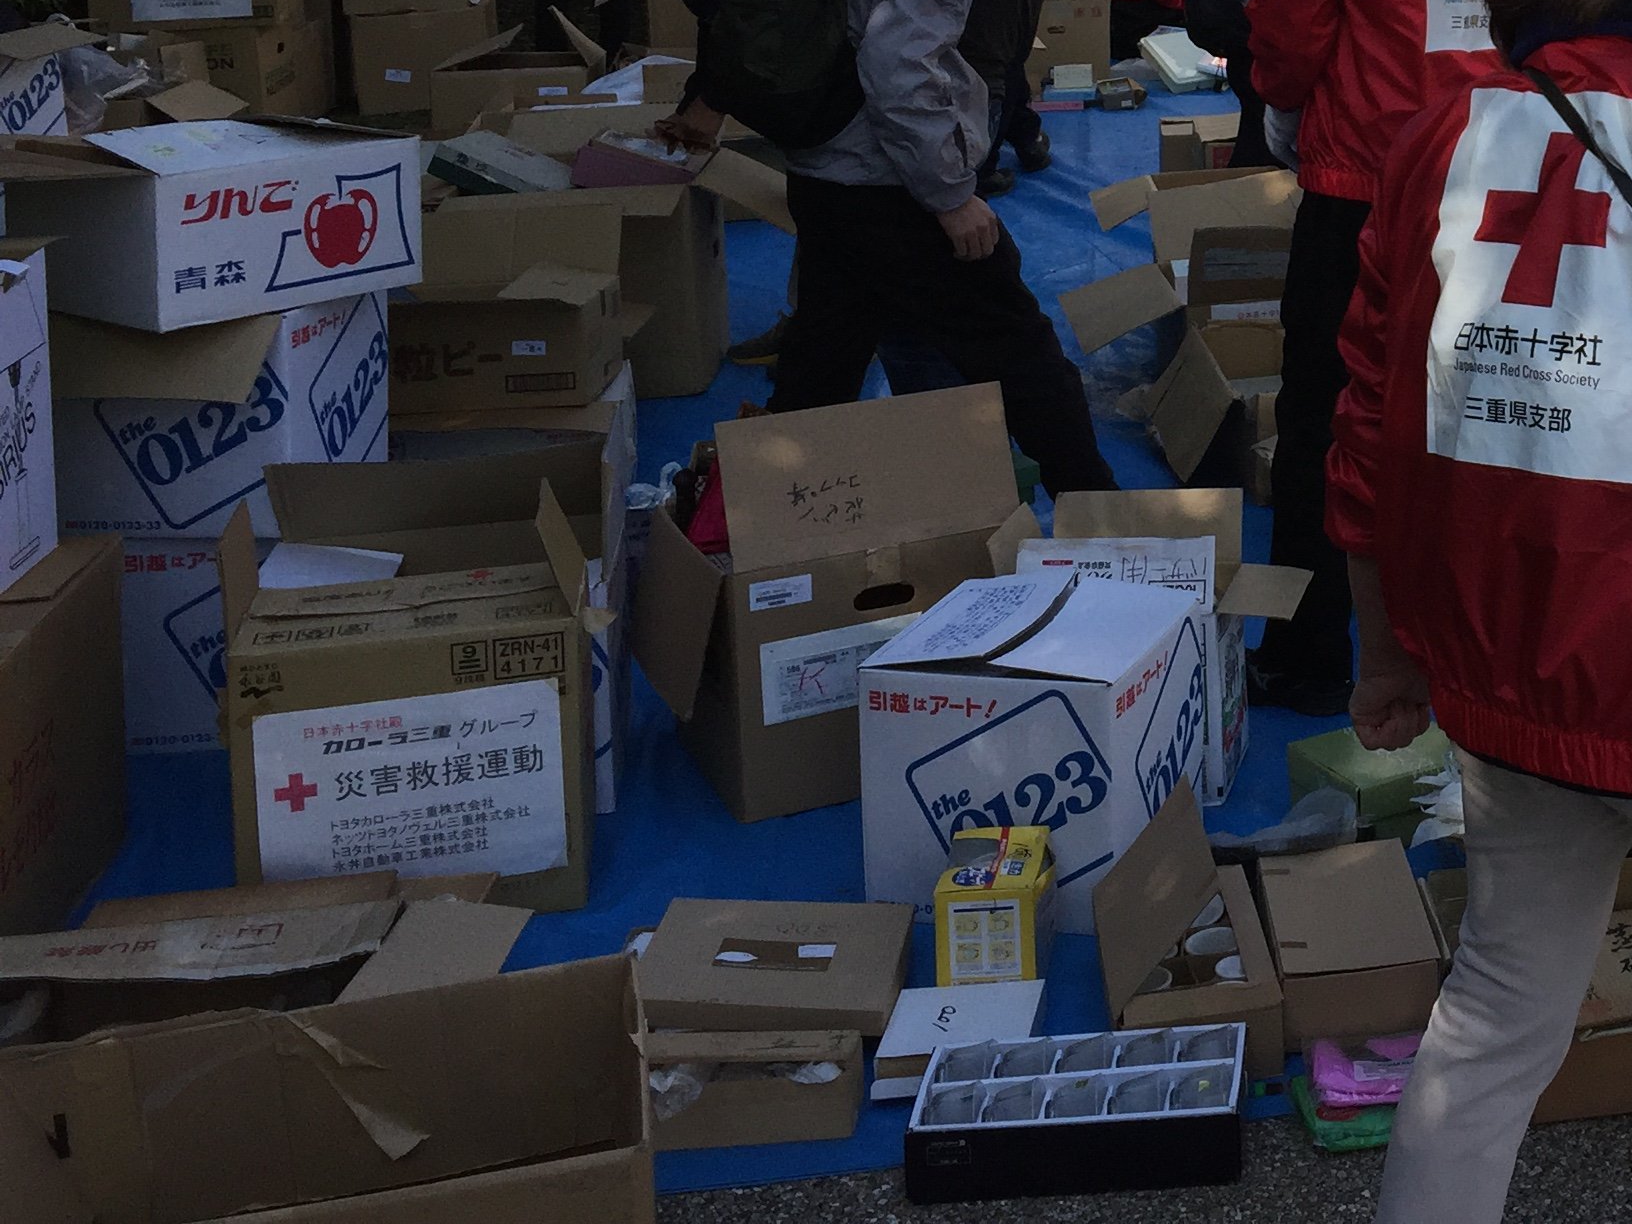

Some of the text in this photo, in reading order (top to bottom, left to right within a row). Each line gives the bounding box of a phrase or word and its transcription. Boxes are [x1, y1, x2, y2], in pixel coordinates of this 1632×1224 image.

[174, 260, 247, 295] 青森
[1454, 322, 1603, 367] 日本赤十字社
[1500, 362, 1520, 378] Red
[1522, 364, 1552, 382] Cross
[1554, 369, 1601, 391] Society
[118, 415, 157, 445] the
[136, 376, 285, 487] 0123
[1464, 395, 1572, 434] 三重県支部
[498, 636, 559, 658] ZRN-41
[500, 654, 559, 675] 4171
[335, 743, 544, 802] 災害救援運動
[330, 797, 495, 832] トヨタカローラ三重株式会社
[932, 789, 972, 821] the
[331, 825, 489, 860] トヨタホーム三重株式会社
